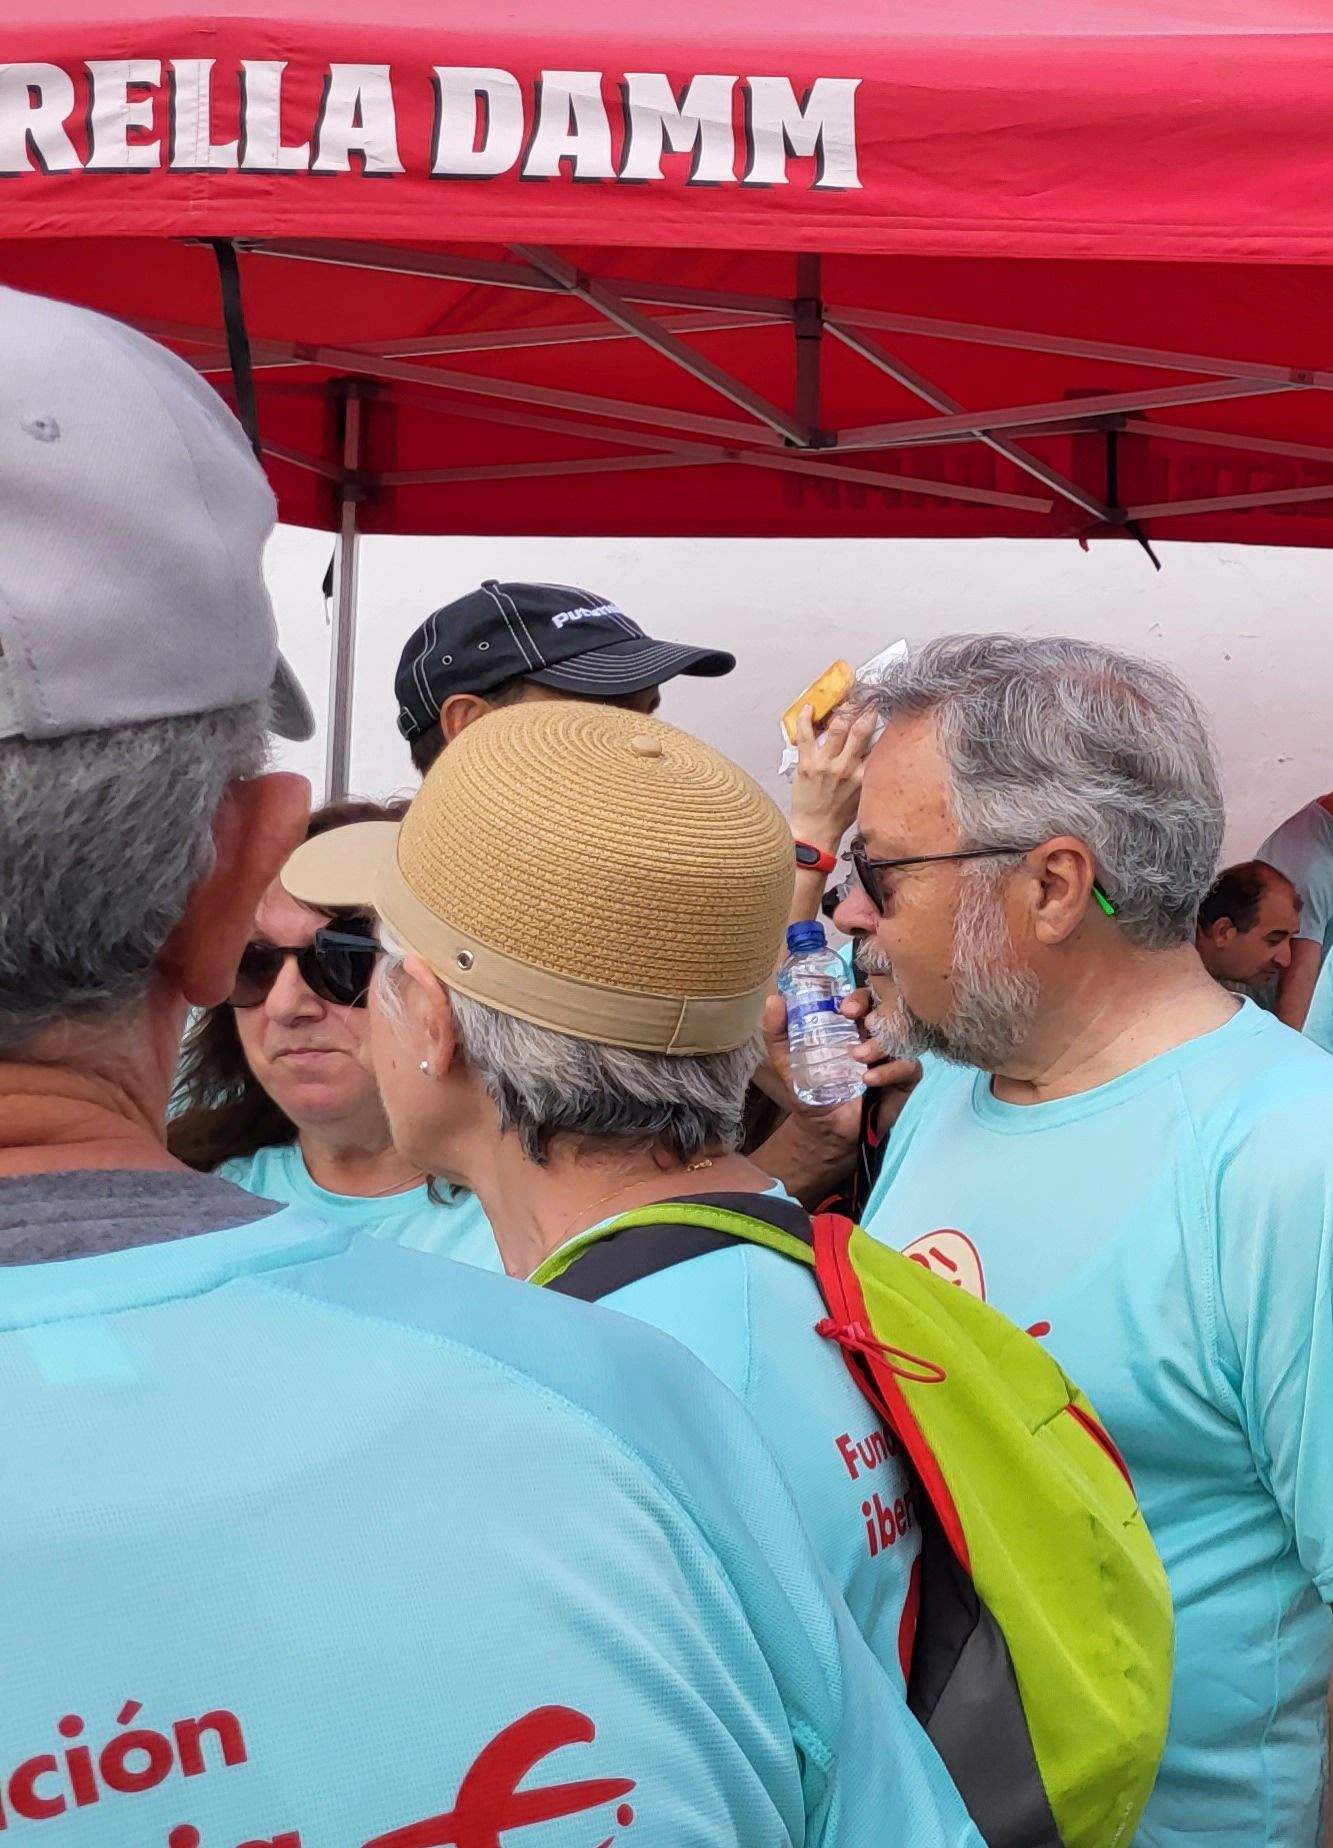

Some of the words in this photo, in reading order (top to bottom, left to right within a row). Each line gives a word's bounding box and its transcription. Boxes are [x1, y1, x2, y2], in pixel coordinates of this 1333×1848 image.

[0, 59, 406, 176] RELLA
[430, 66, 863, 190] DAMM
[0, 1700, 248, 1831] ción
